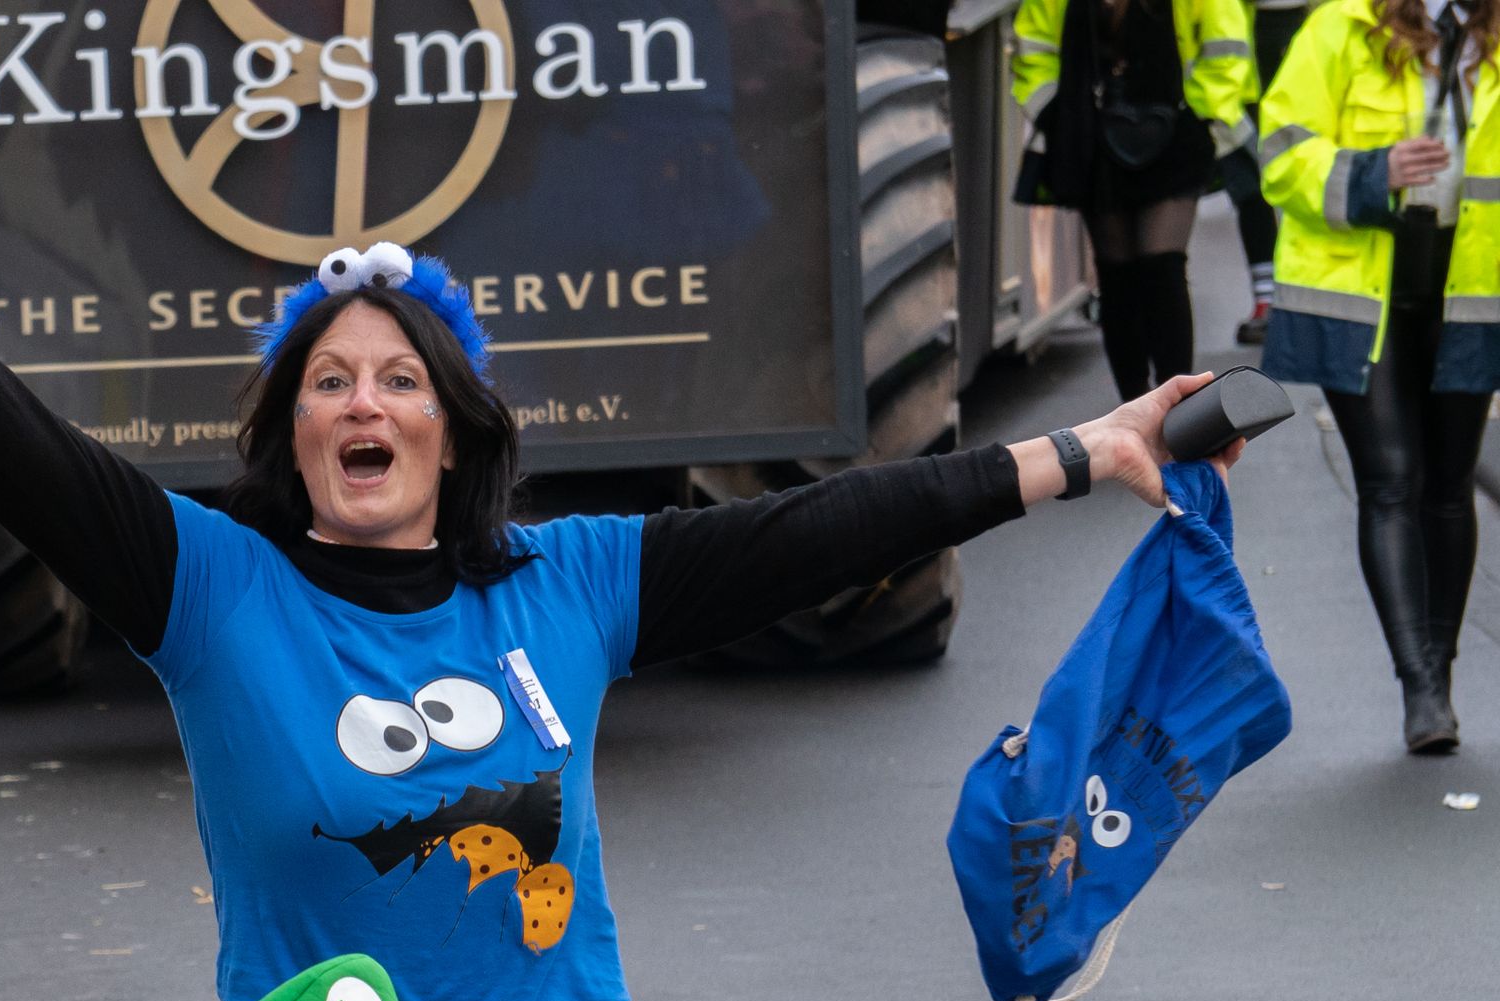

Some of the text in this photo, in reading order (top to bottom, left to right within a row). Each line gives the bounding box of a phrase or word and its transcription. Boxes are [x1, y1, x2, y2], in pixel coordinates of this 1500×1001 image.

[148, 286, 295, 331] SEC
[449, 265, 710, 316] ERVICE
[509, 398, 569, 431] pelt
[576, 395, 629, 422] e.V.
